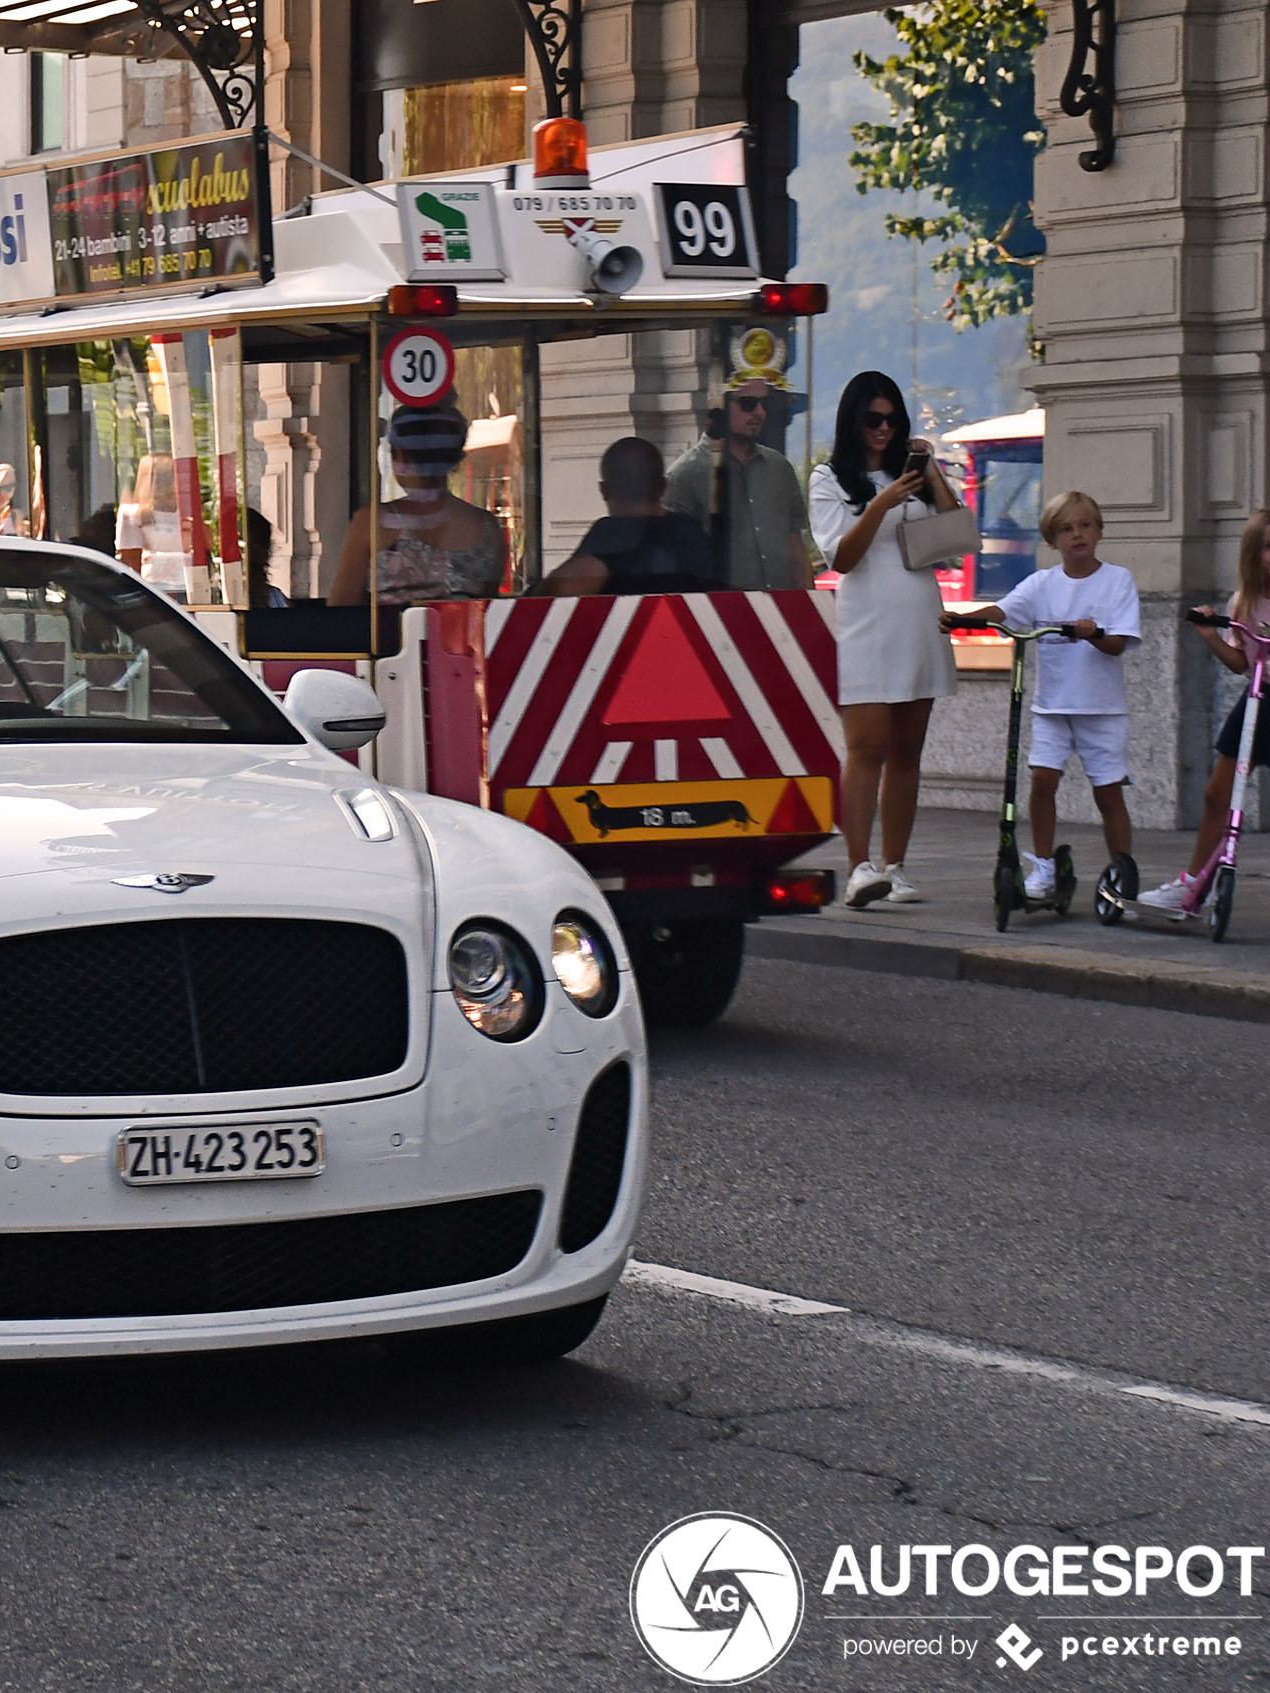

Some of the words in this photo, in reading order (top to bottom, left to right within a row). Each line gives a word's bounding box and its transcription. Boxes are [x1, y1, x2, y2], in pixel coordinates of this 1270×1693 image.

[146, 152, 250, 215] scuolabus
[441, 192, 480, 201] GRAZIE
[513, 196, 543, 212] 079
[559, 196, 589, 211] 685
[595, 196, 612, 211] 70
[619, 196, 637, 210] 70
[86, 230, 131, 256] bambini
[138, 224, 167, 252] 3-12
[170, 220, 197, 244] anni
[206, 214, 249, 239] autista
[674, 200, 736, 257] 99
[142, 256, 155, 276] 79
[159, 253, 180, 273] 685
[183, 250, 197, 270] 70
[198, 248, 212, 268] 70
[401, 349, 436, 383] 30
[640, 807, 664, 826] 18
[671, 810, 696, 825] m.
